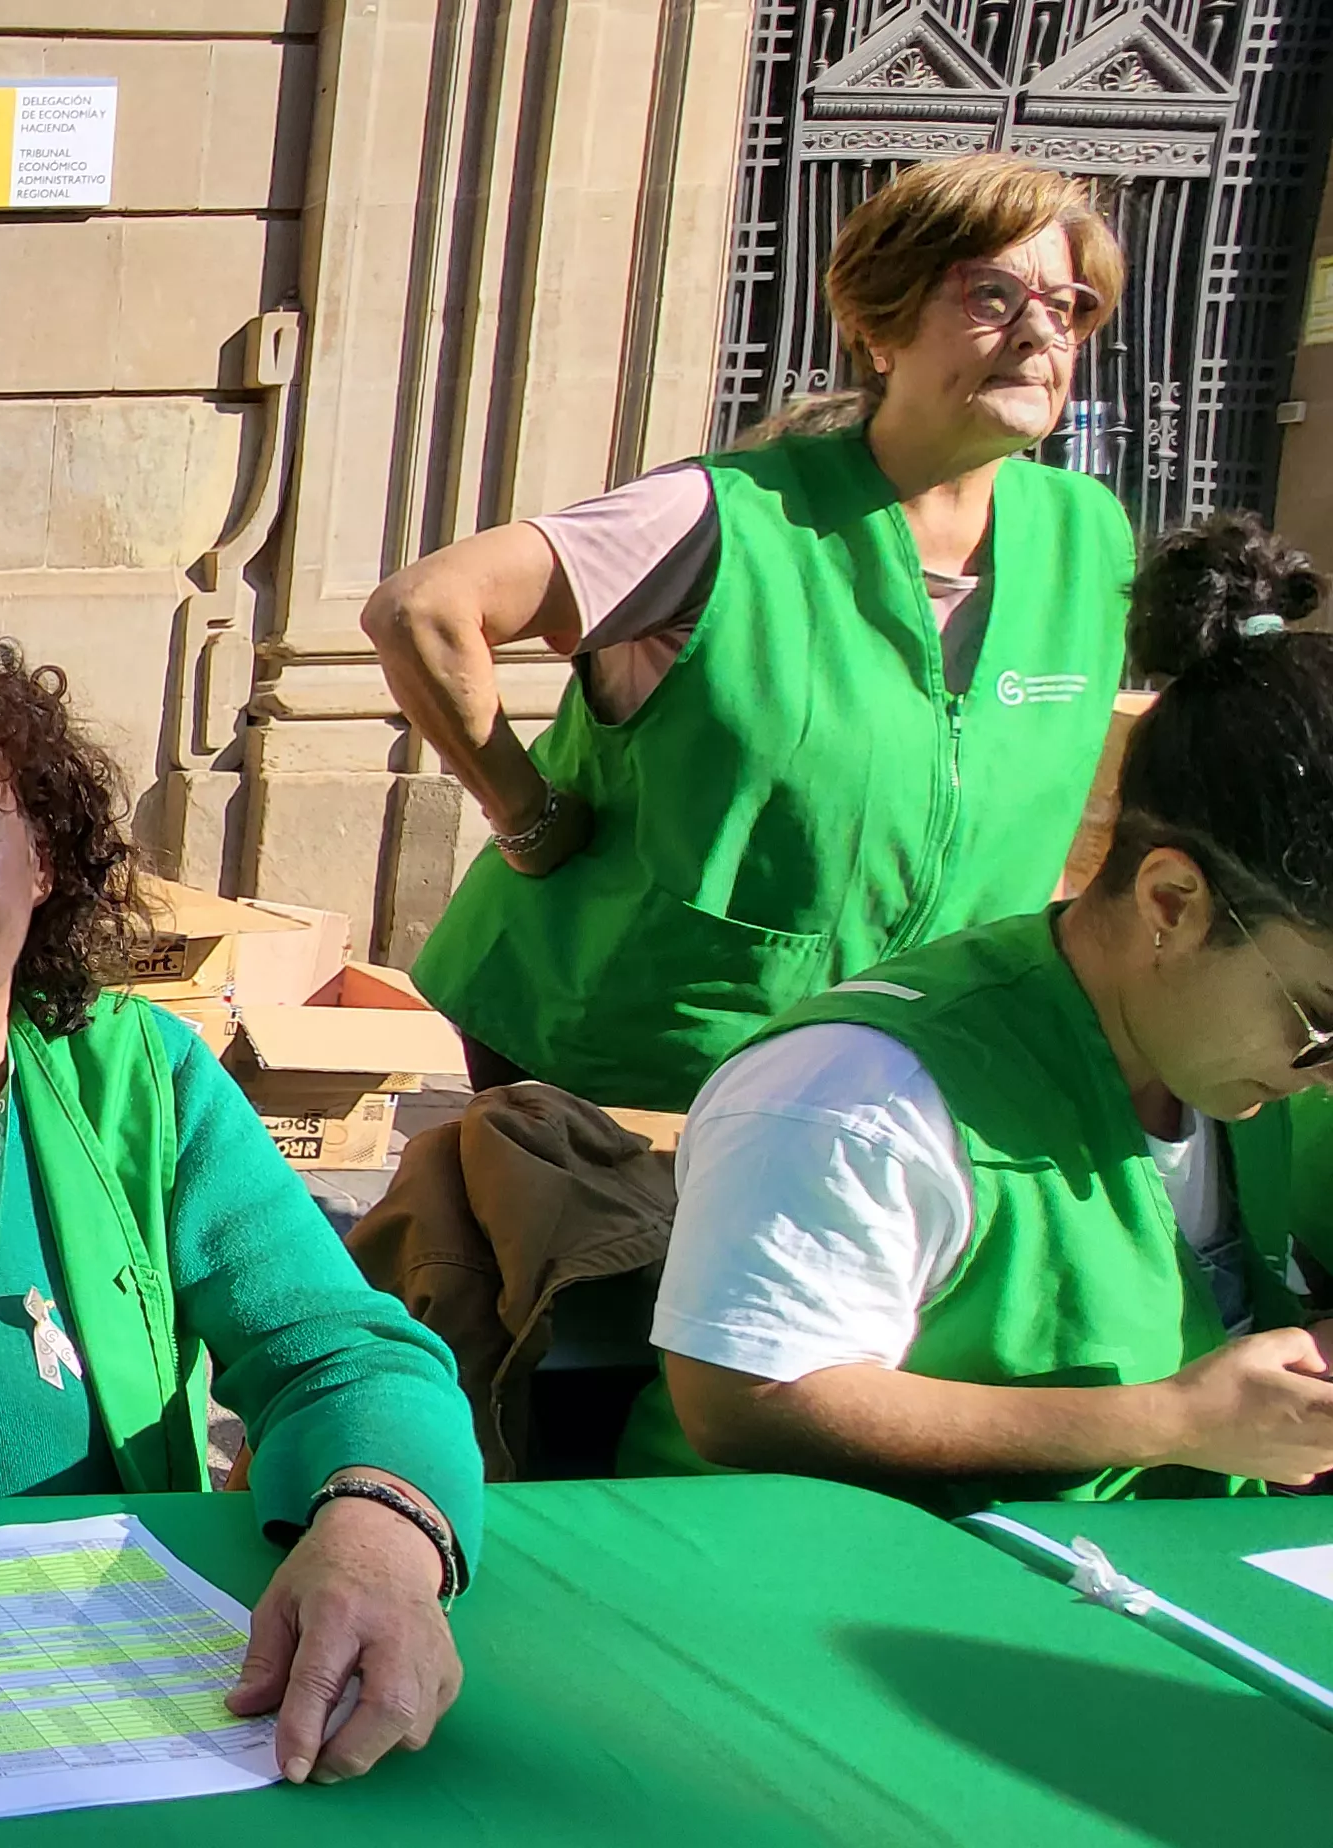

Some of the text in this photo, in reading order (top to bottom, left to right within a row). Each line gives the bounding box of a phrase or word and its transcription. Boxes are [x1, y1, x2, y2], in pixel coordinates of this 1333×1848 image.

[22, 94, 92, 106] DELEGACIÓN
[21, 107, 107, 120] DE ECONOMÍA Y
[20, 123, 76, 133] HACIENDA
[19, 148, 72, 158] TRIBUNAL
[18, 160, 88, 172] ECONÓMICO
[17, 175, 106, 185] ADMINISTRATIVO
[16, 188, 71, 199] REGIONAL
